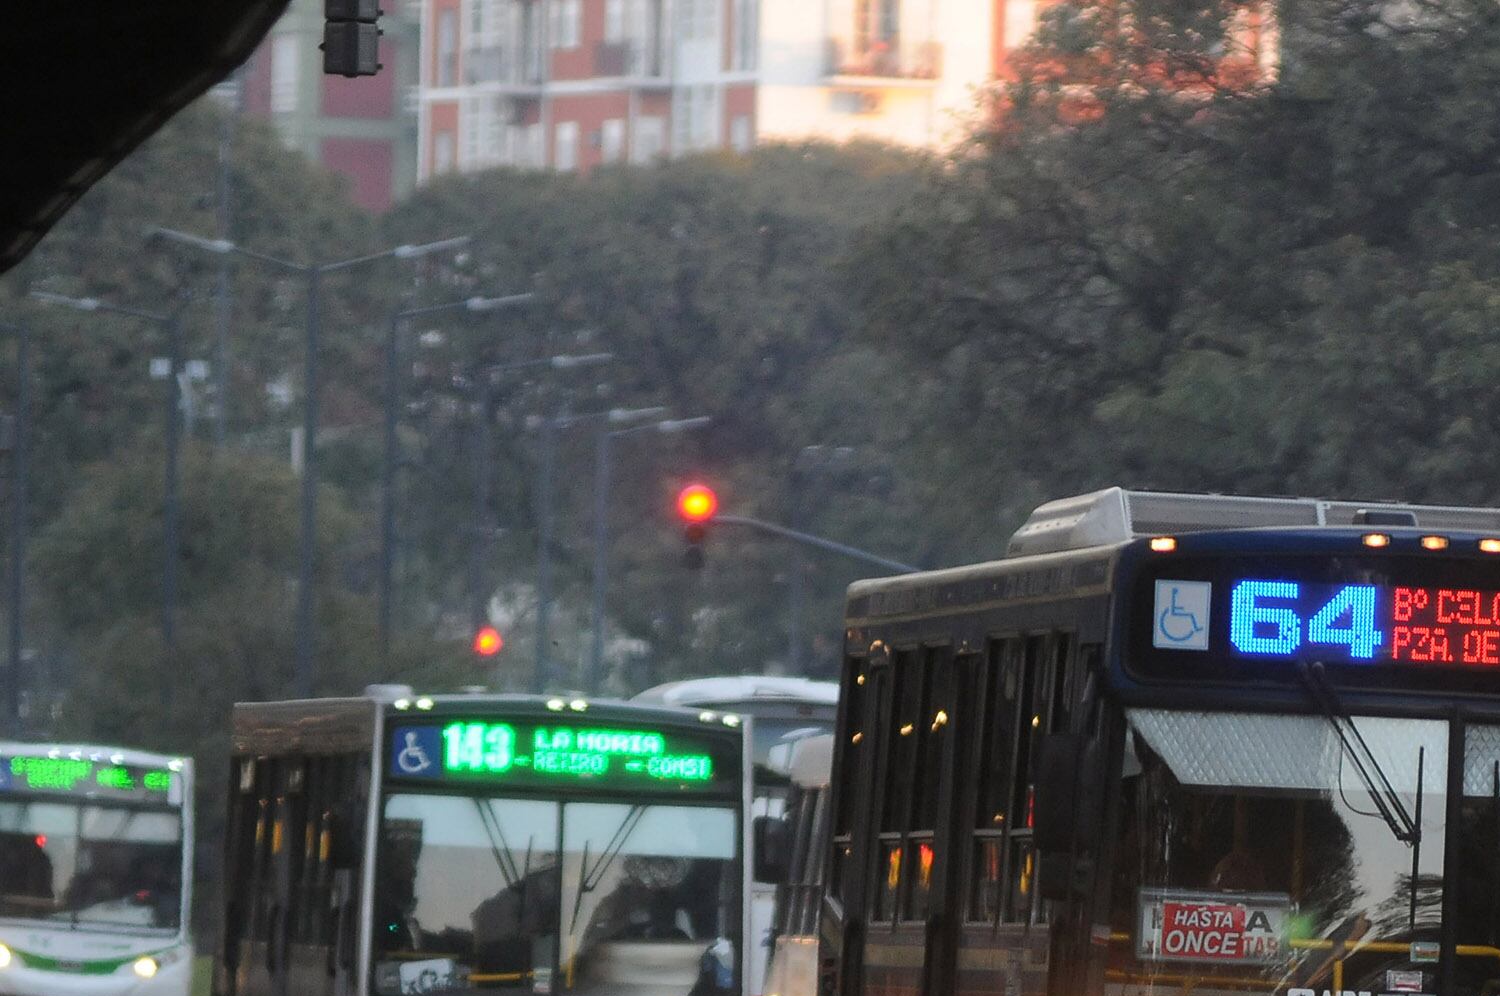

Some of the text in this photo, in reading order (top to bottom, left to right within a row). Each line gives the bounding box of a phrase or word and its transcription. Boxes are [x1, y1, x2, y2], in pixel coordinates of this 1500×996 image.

[1231, 580, 1382, 658] 64
[443, 722, 514, 772] 143
[1174, 909, 1234, 928] HASTA
[1165, 930, 1240, 955] ONCE
